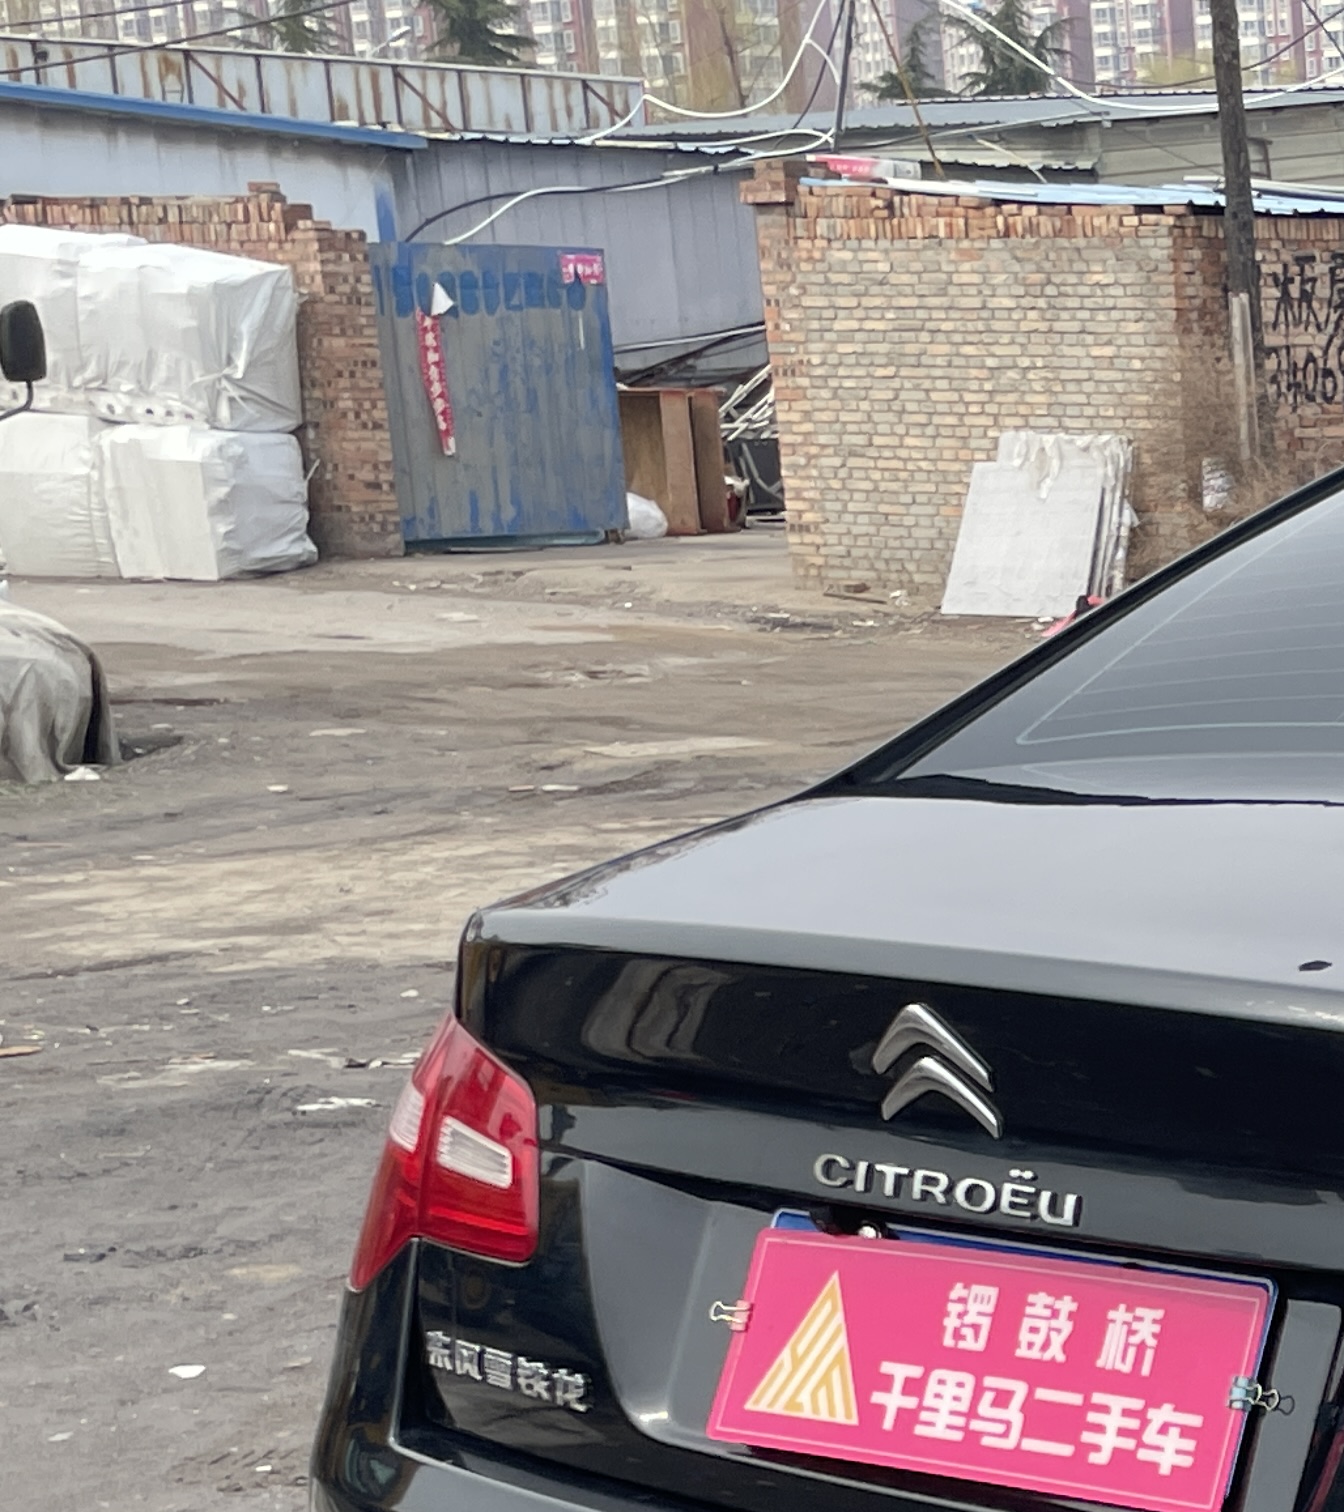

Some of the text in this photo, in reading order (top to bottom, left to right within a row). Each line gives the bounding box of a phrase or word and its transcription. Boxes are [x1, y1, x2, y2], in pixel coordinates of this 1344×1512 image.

[426, 1330, 591, 1413] 东风雪铁龙
[942, 1282, 1165, 1377] 锣鼓桥
[870, 1361, 1204, 1476] 千里马二手车
